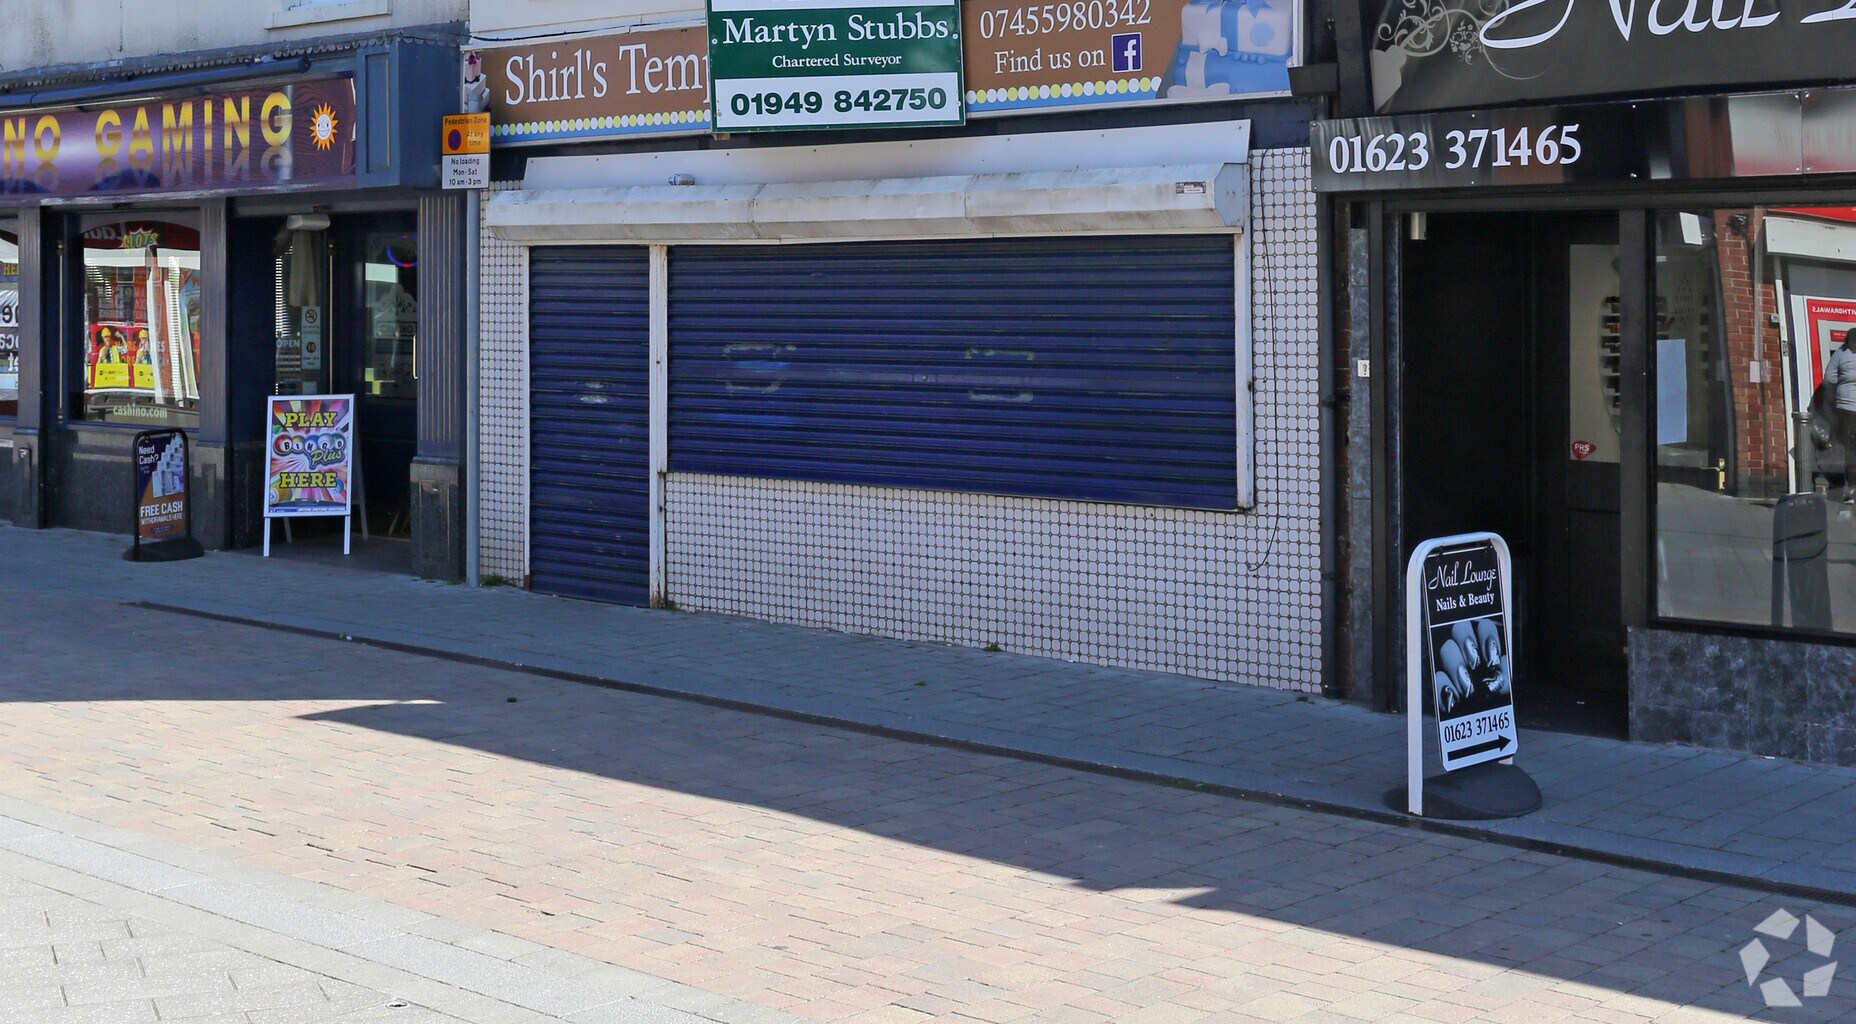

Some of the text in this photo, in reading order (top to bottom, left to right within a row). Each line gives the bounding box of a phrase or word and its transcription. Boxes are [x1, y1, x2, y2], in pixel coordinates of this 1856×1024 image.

[722, 17, 838, 50] Martyn
[772, 53, 903, 69] Chartered Surveyor
[994, 47, 1042, 74] Find
[1048, 52, 1072, 70] us
[1078, 49, 1106, 68] on
[505, 48, 608, 106] Shirl's
[730, 87, 947, 116] 01949 842750
[95, 91, 293, 160] GAMING
[444, 116, 487, 125] Pedestrian Zone
[1328, 123, 1582, 173] 01623 371465
[460, 157, 480, 165] loading
[453, 168, 465, 176] Mon
[276, 339, 300, 348] OPEN
[112, 402, 168, 418] cashino.com
[285, 412, 337, 427] PLAY
[139, 445, 155, 455] Need
[281, 438, 344, 453] BINGO
[1574, 443, 1590, 452] PRS
[139, 454, 159, 465] Cash?
[311, 449, 342, 466] Plus
[280, 472, 337, 488] HERE
[140, 500, 183, 517] FREE CASH
[1428, 560, 1497, 591] Nail Lounge
[1436, 592, 1495, 612] Nails & Beauty
[1444, 711, 1510, 744] 01623 371465
